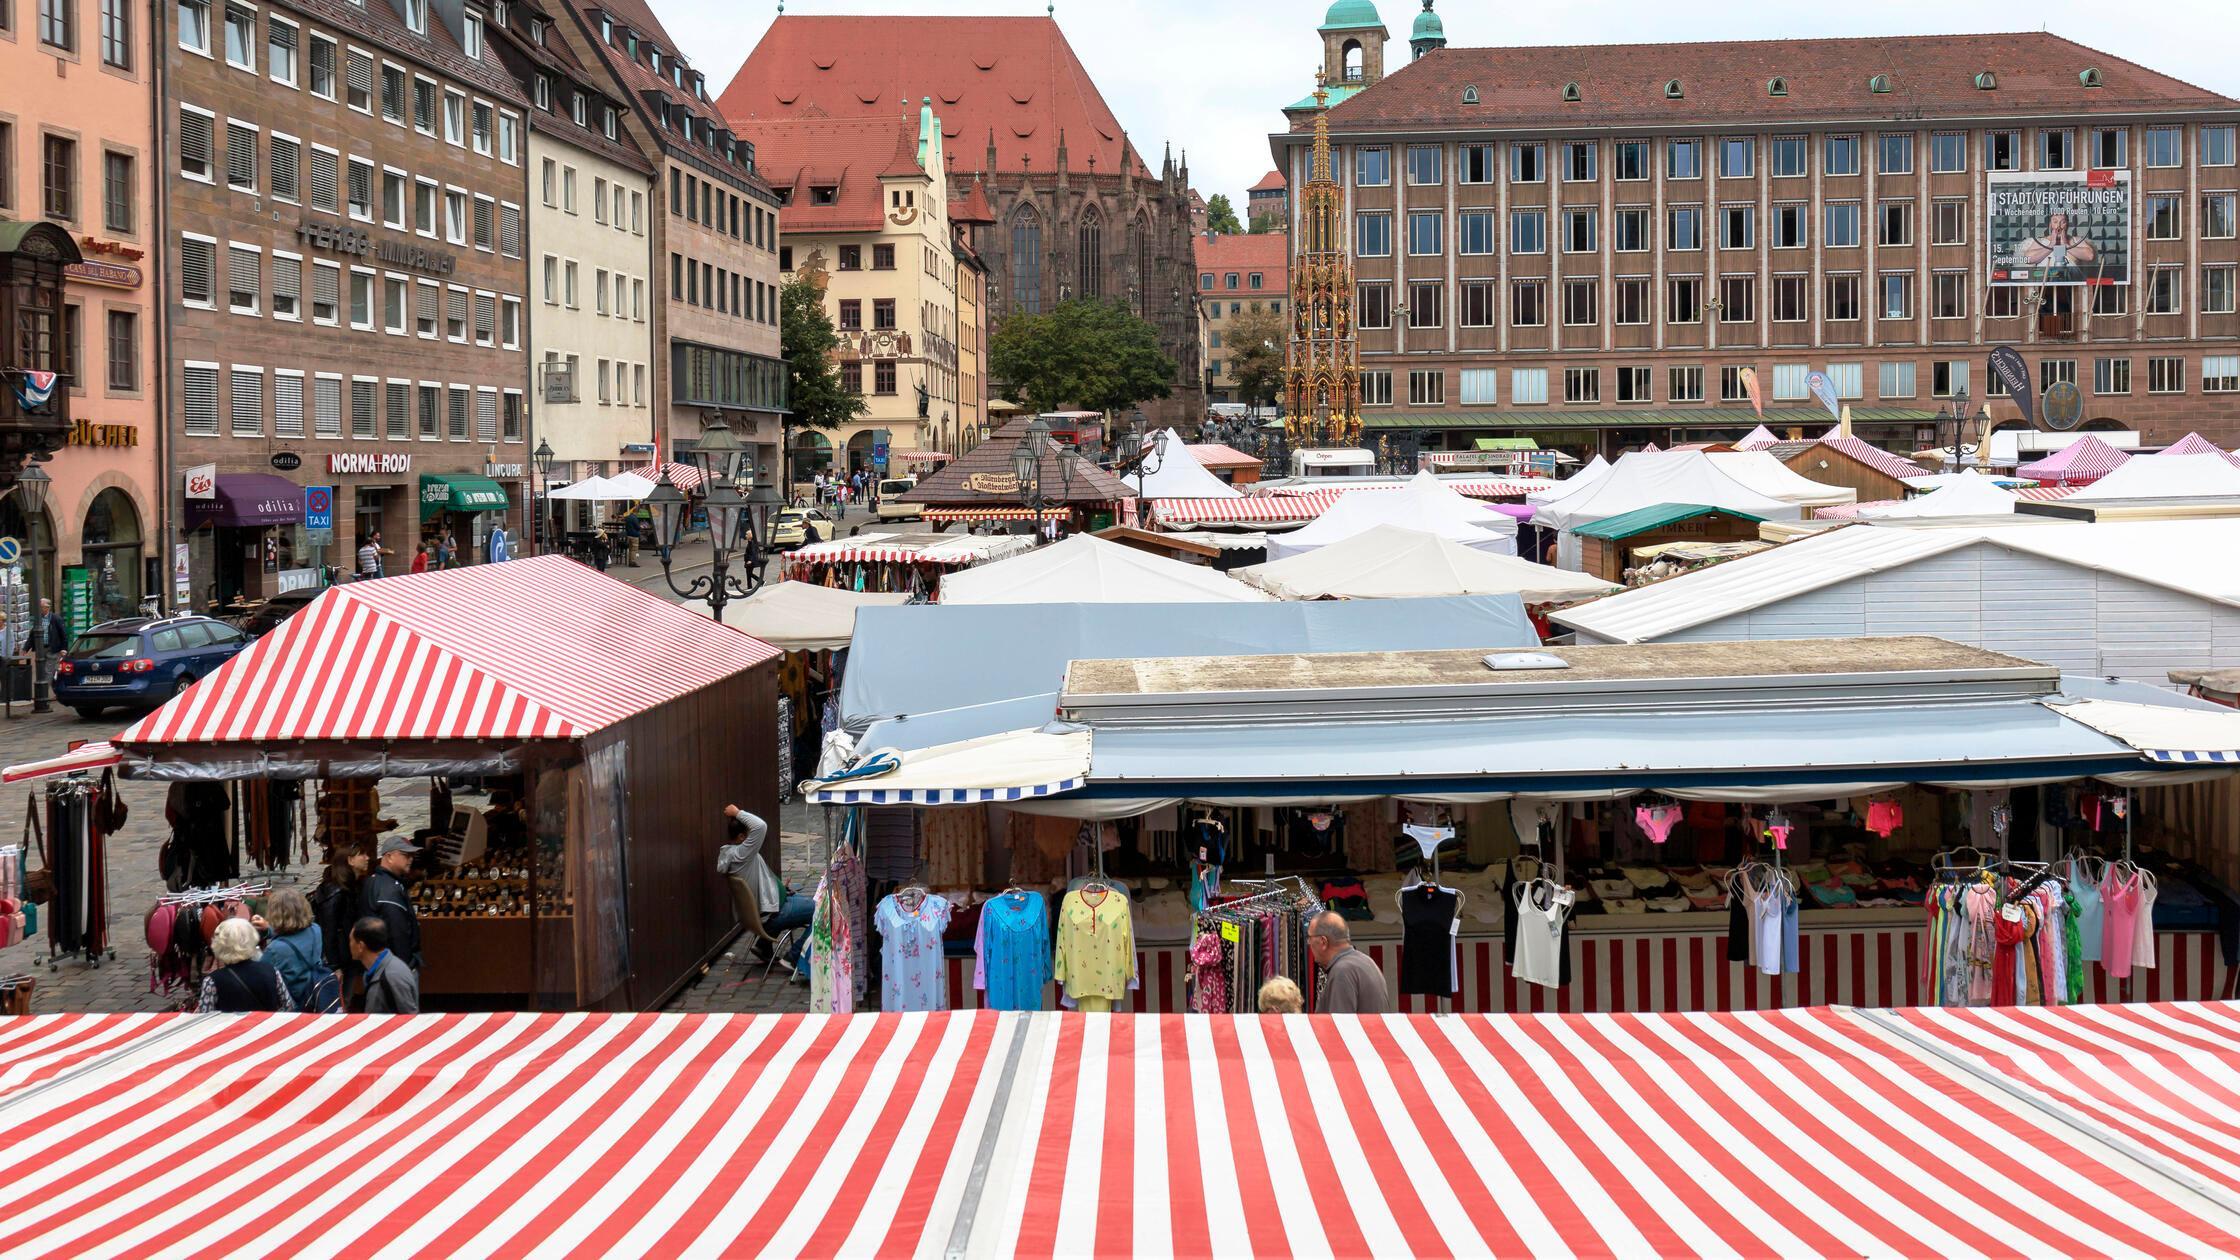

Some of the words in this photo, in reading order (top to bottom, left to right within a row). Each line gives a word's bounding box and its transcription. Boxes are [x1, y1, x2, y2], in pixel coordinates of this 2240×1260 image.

[1999, 190, 2124, 206] STADT(VER)FÜHRUNGEN
[2004, 208, 2045, 216] Wochenende
[2066, 207, 2088, 215] Routen
[2094, 206, 2101, 215] 10
[1993, 244, 2004, 253] 15.
[1992, 254, 2031, 266] September
[69, 418, 138, 447] BÜCHER
[273, 457, 299, 466] odilia
[486, 463, 523, 478] LINCURA
[258, 500, 294, 513] odilia
[308, 516, 329, 526] TAXI
[1662, 522, 1704, 533] IMKER
